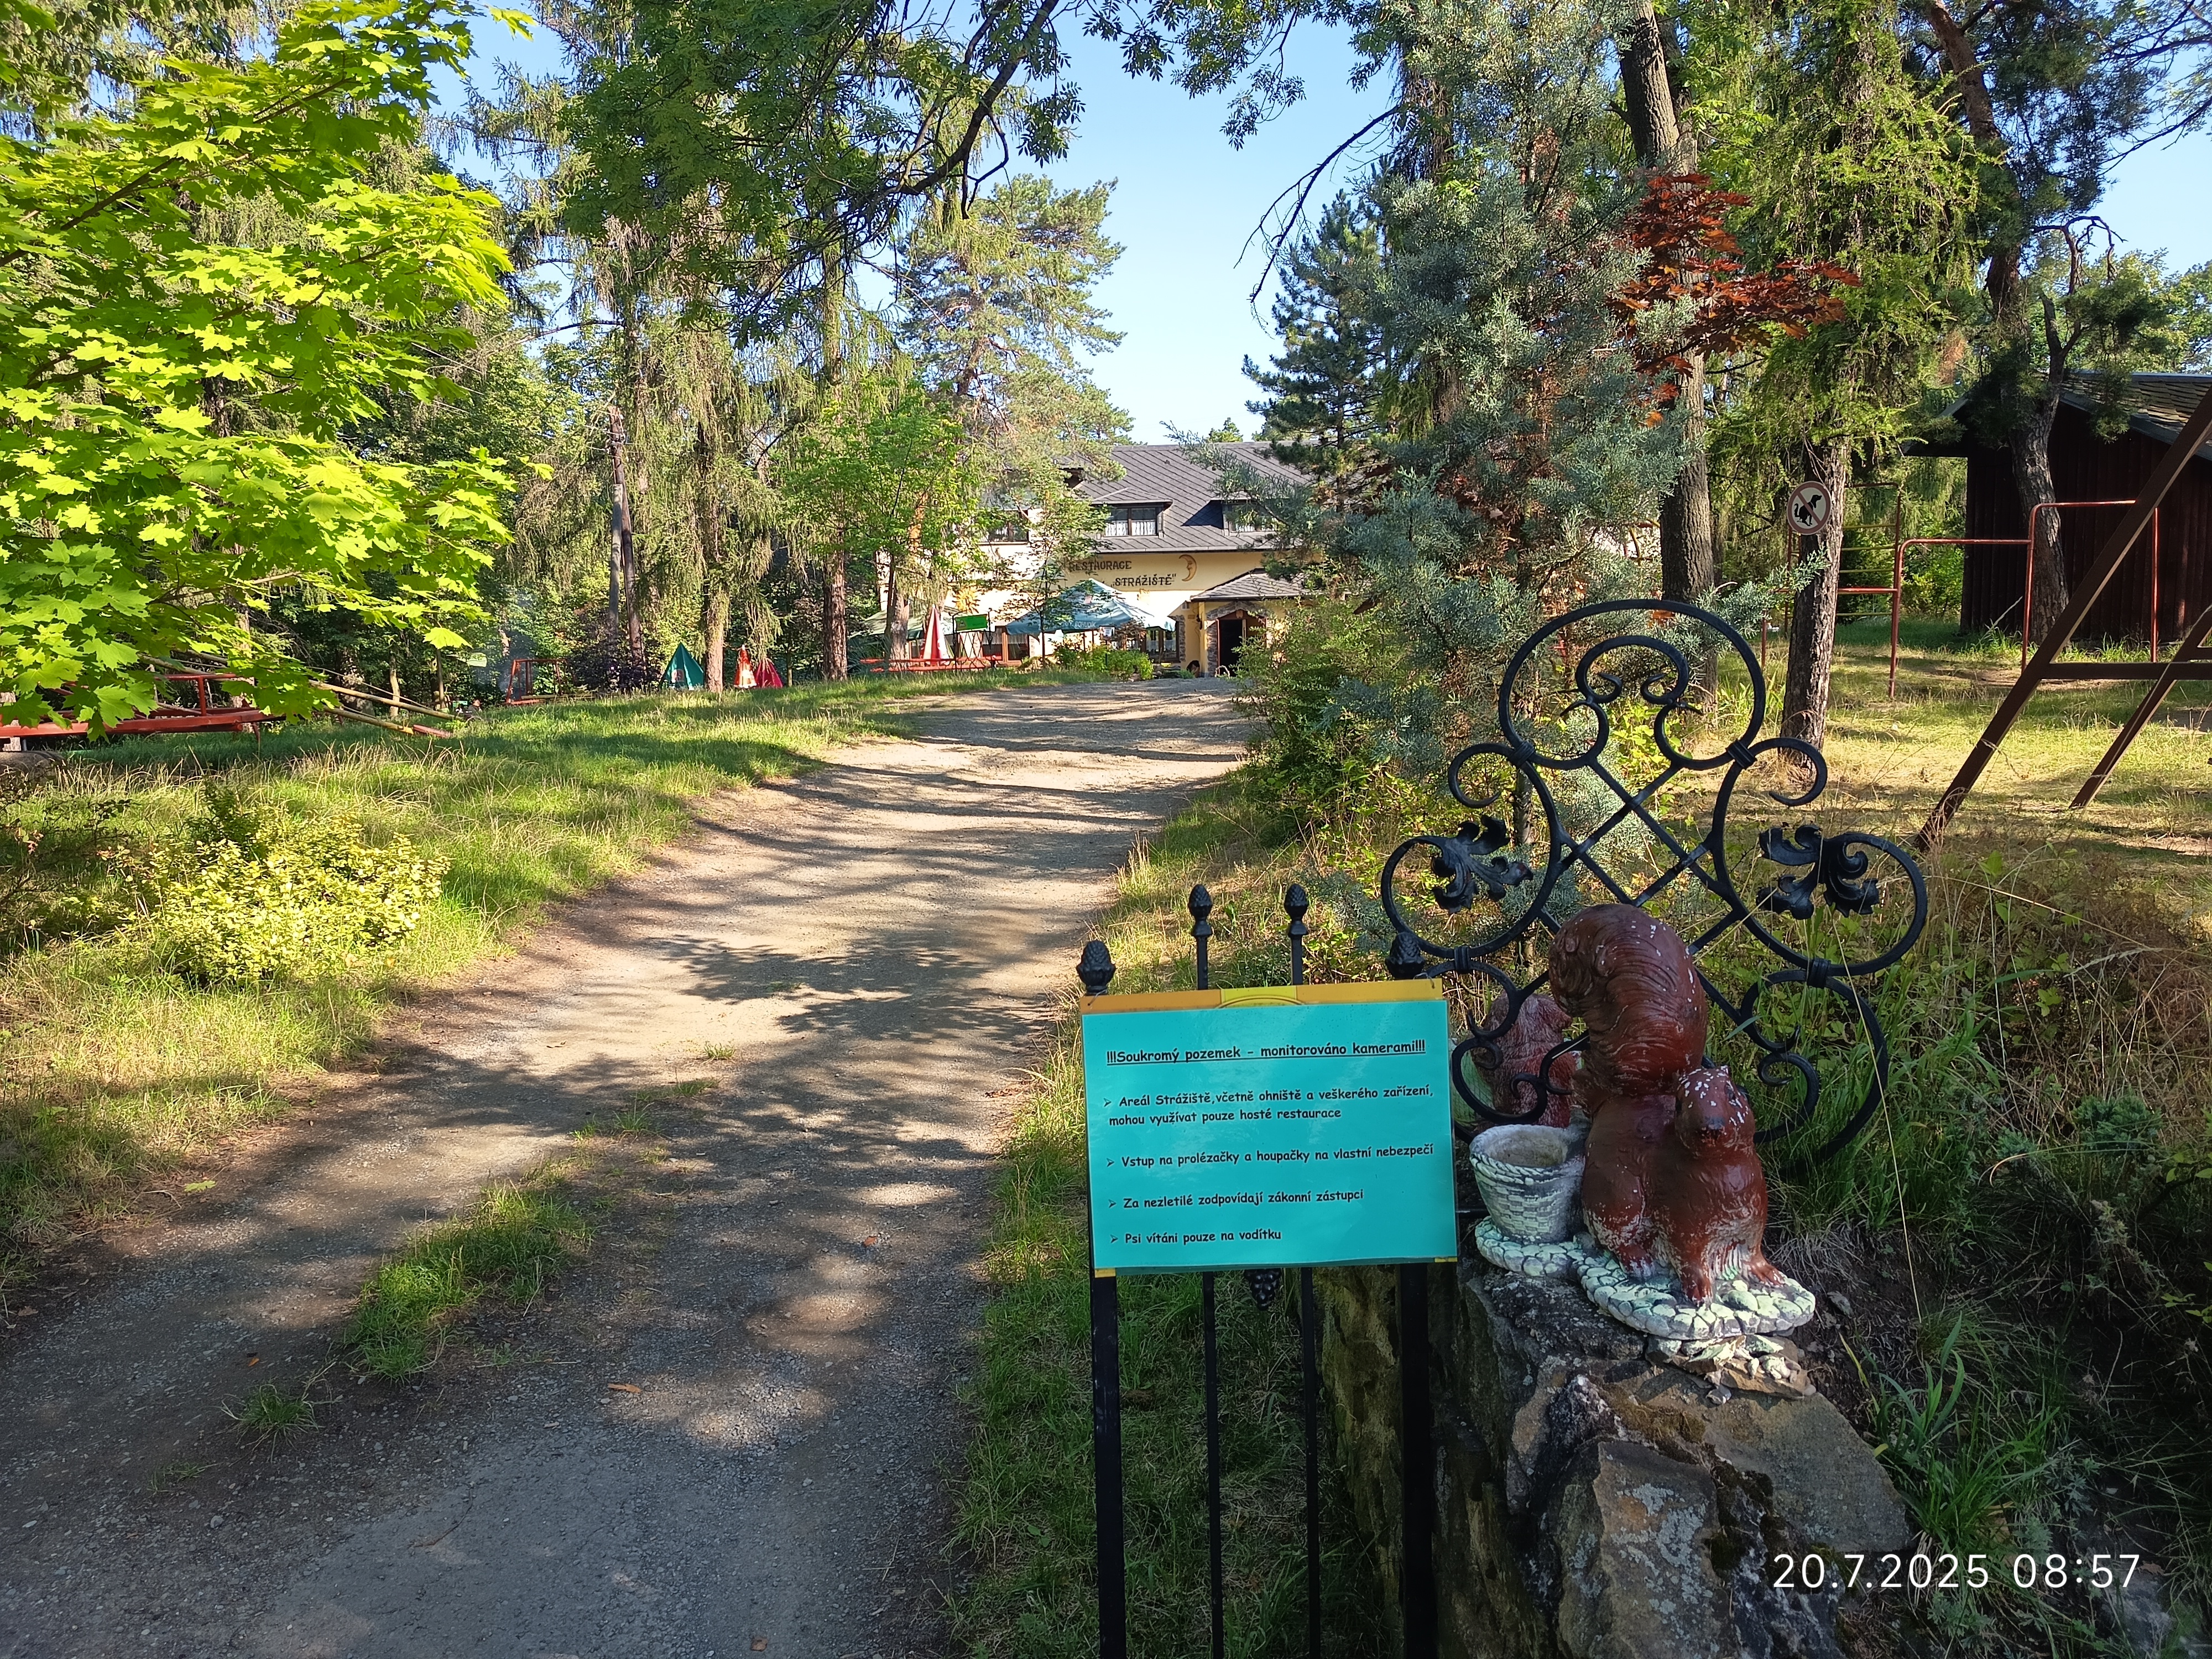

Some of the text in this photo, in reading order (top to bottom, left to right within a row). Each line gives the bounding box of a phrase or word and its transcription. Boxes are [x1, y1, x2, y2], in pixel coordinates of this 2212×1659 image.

[1107, 1047, 1180, 1063] !!!Soukromý
[1185, 1046, 1241, 1063] pozemek
[1261, 1042, 1347, 1056] monitorováno
[1353, 1039, 1426, 1052] kamerami!!!
[1119, 1094, 1150, 1107] Areál
[1259, 1089, 1302, 1101] ohniště
[1318, 1087, 1378, 1100] veškerého
[1383, 1083, 1433, 1098] zařízení,
[1109, 1108, 1342, 1126] mohou využívat pouze hosté restaurace
[1121, 1156, 1155, 1169] Vstup
[1159, 1157, 1173, 1165] na
[1177, 1151, 1240, 1167] prolézačky
[1256, 1149, 1310, 1164] houpačky
[1315, 1152, 1329, 1160] na
[1333, 1146, 1372, 1159] vlastní
[1376, 1143, 1433, 1158] nebezpečí
[1123, 1188, 1363, 1208] Za nezletilé zodpovídají zákonní zástupci
[1125, 1228, 1281, 1246] Psi vítáni pouze na vodítku
